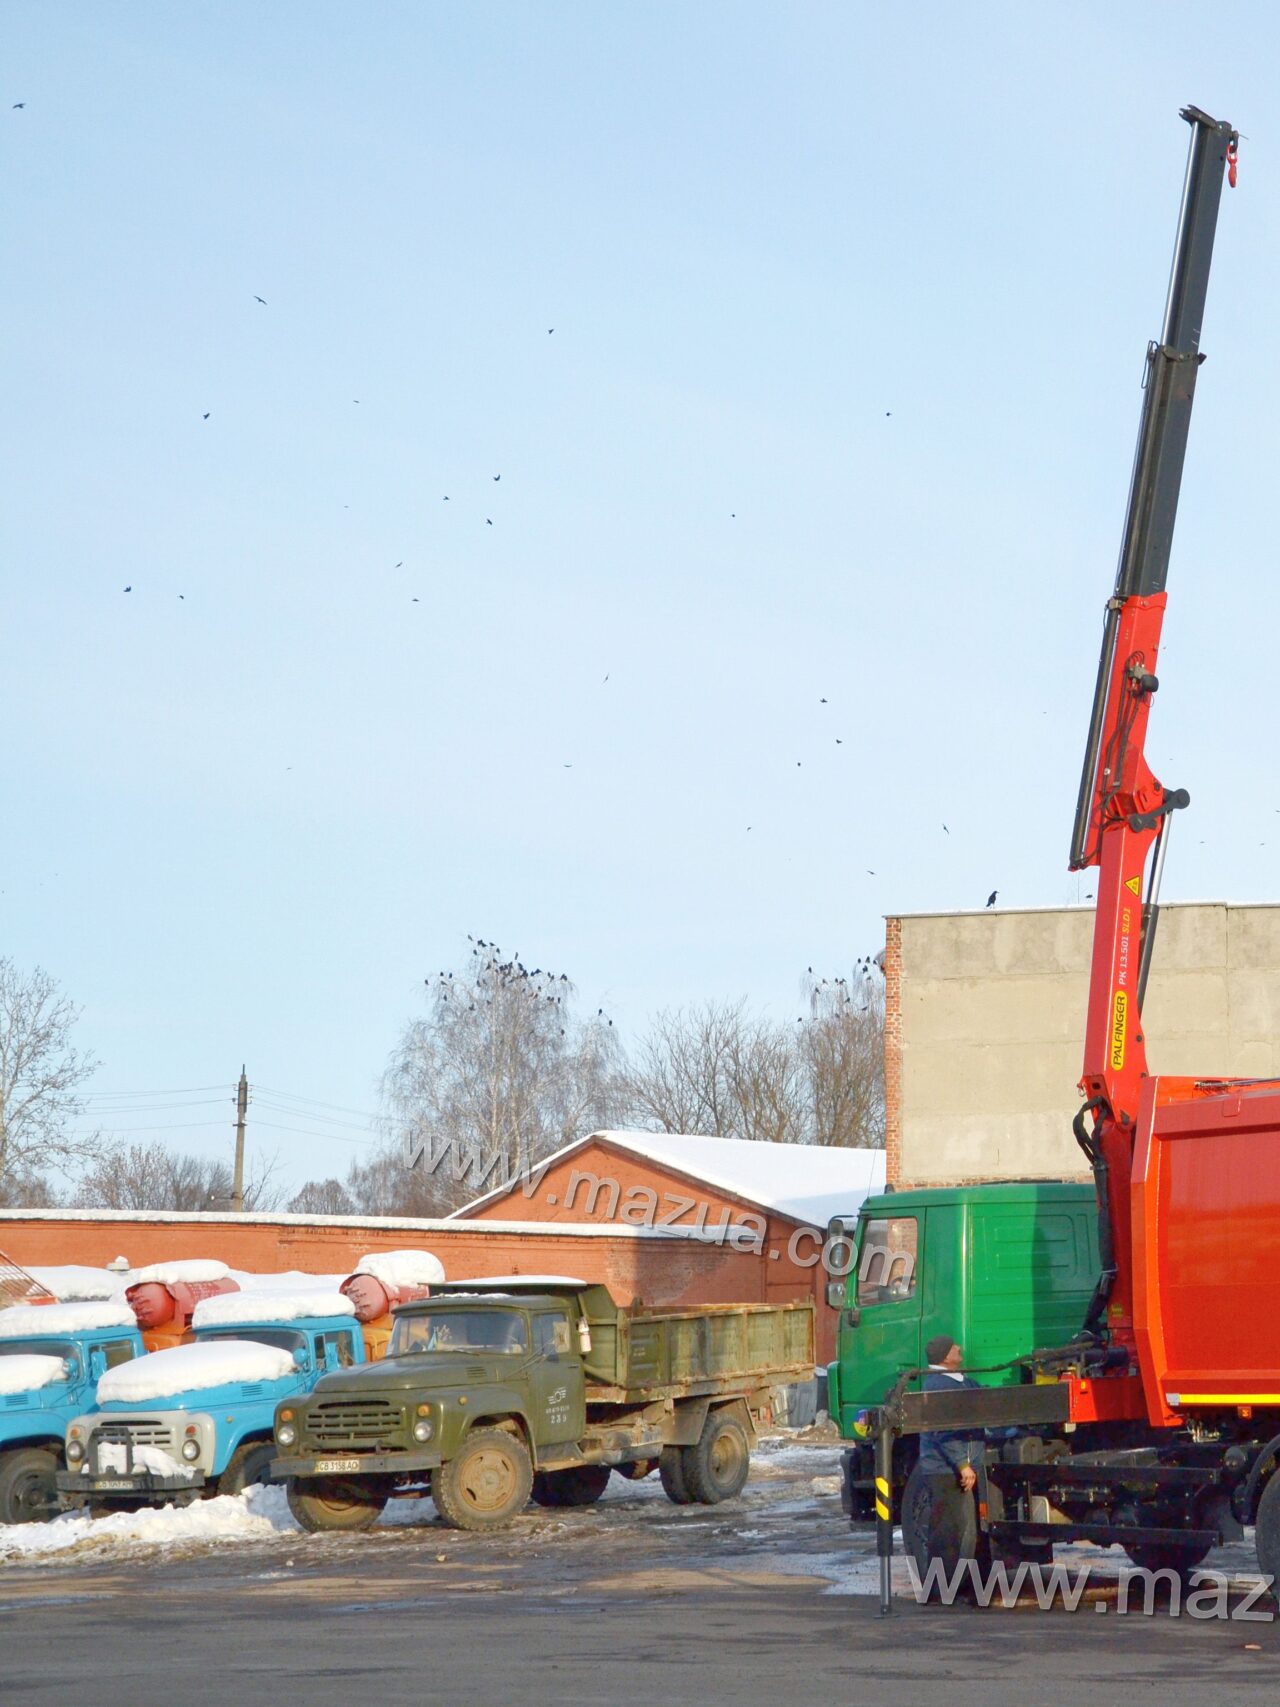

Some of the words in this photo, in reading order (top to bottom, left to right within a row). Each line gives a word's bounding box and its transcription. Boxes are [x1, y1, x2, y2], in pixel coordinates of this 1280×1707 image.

[1121, 908, 1131, 934] SLD1
[1119, 935, 1129, 969] 13.501
[1118, 971, 1127, 985] PK
[1112, 995, 1126, 1066] PALFINGER
